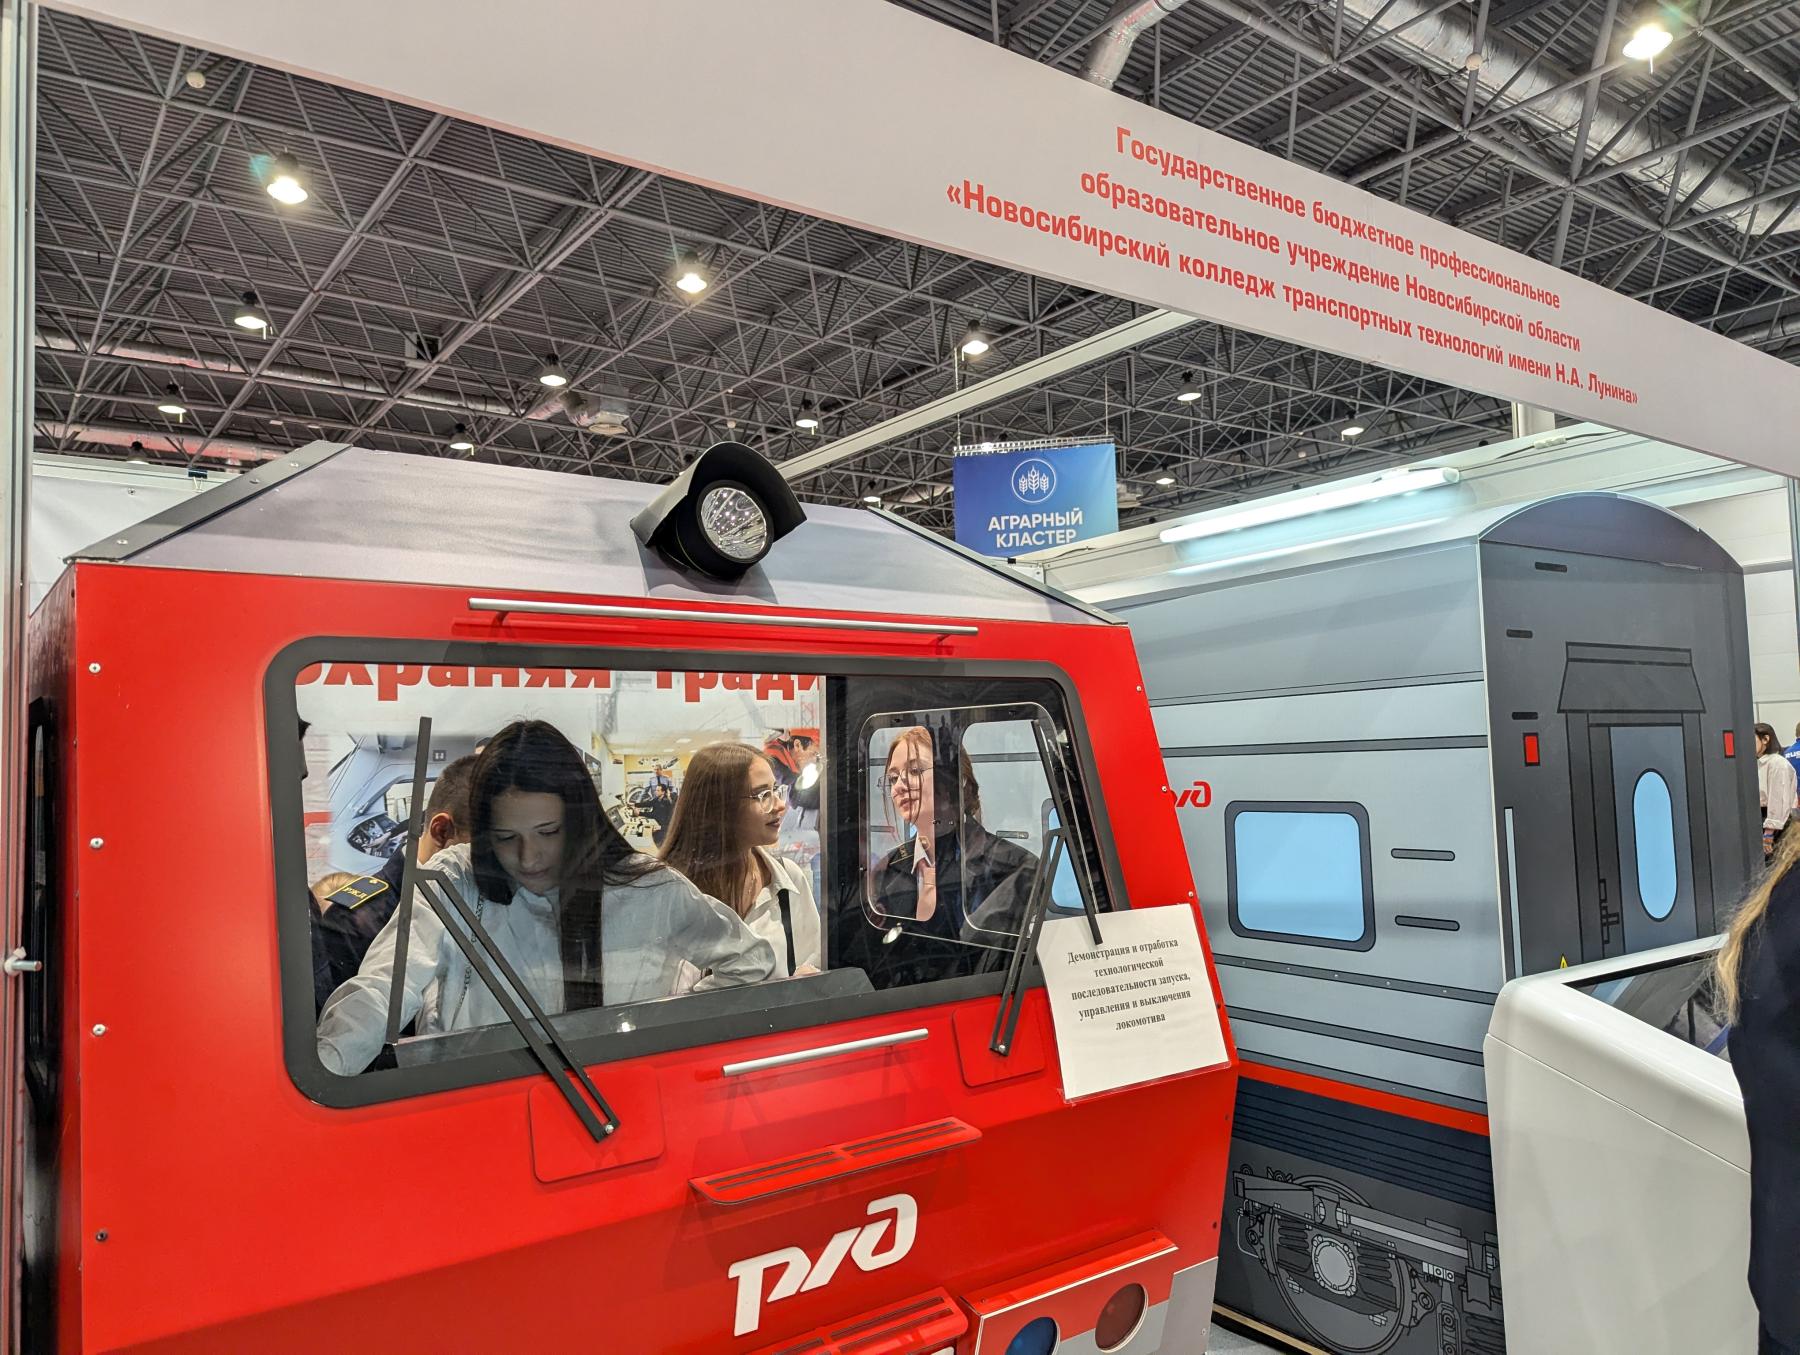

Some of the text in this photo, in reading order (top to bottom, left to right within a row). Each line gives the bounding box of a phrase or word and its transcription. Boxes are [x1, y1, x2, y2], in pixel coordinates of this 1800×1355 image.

[1116, 126, 1561, 310] Государственное бюджетное профессиональное
[1080, 171, 1582, 352] образовательное учреждение Новосибирской области
[946, 178, 1639, 405] «Новосибирский колледж транспортных технологий имени Н.А. Лунина»
[988, 507, 1084, 532] АГРАРНЫЙ
[996, 529, 1077, 549] КЛАСТЕР
[295, 662, 611, 701] храняя
[1067, 938, 1179, 965] Демонстрация и отработка
[1094, 957, 1164, 977] технологической
[1071, 972, 1191, 1001] последовательности запуска,
[1078, 989, 1191, 1021] управления и выключения
[1115, 1013, 1166, 1031] локомотива
